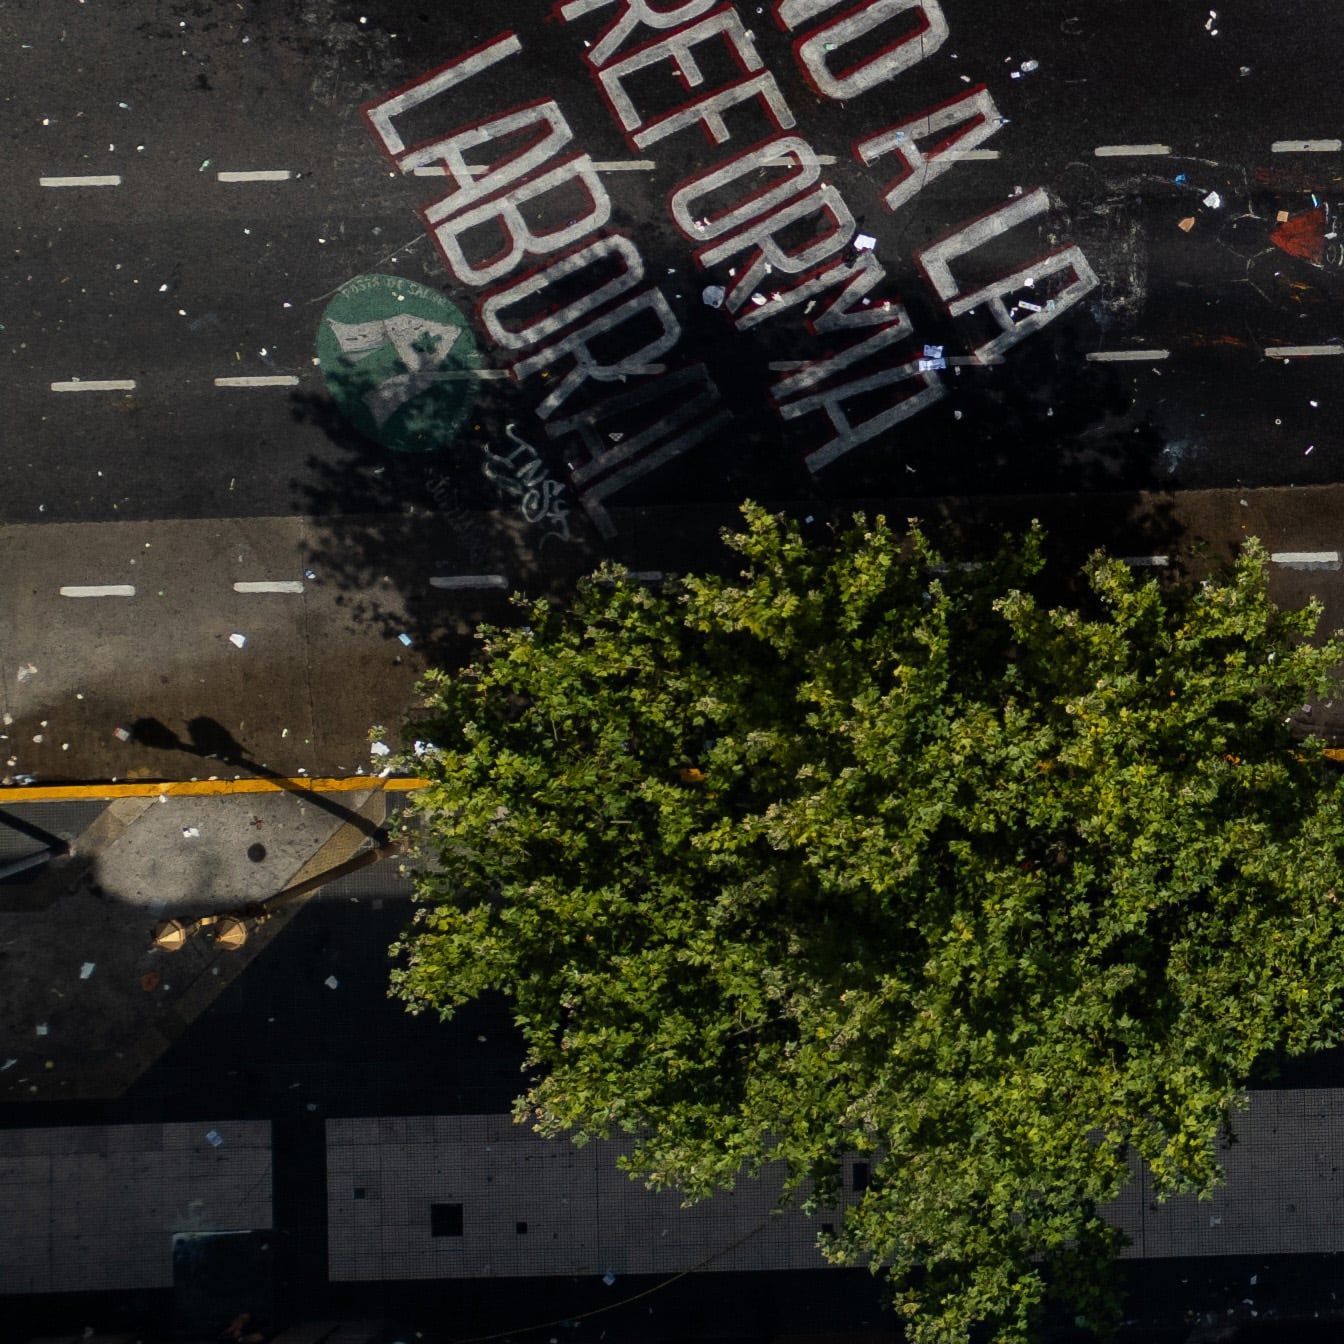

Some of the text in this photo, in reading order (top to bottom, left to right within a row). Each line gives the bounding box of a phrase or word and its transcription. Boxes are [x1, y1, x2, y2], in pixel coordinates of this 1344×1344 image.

[852, 84, 1004, 214] A
[362, 32, 733, 540] LABORAL
[915, 187, 1102, 362] LA
